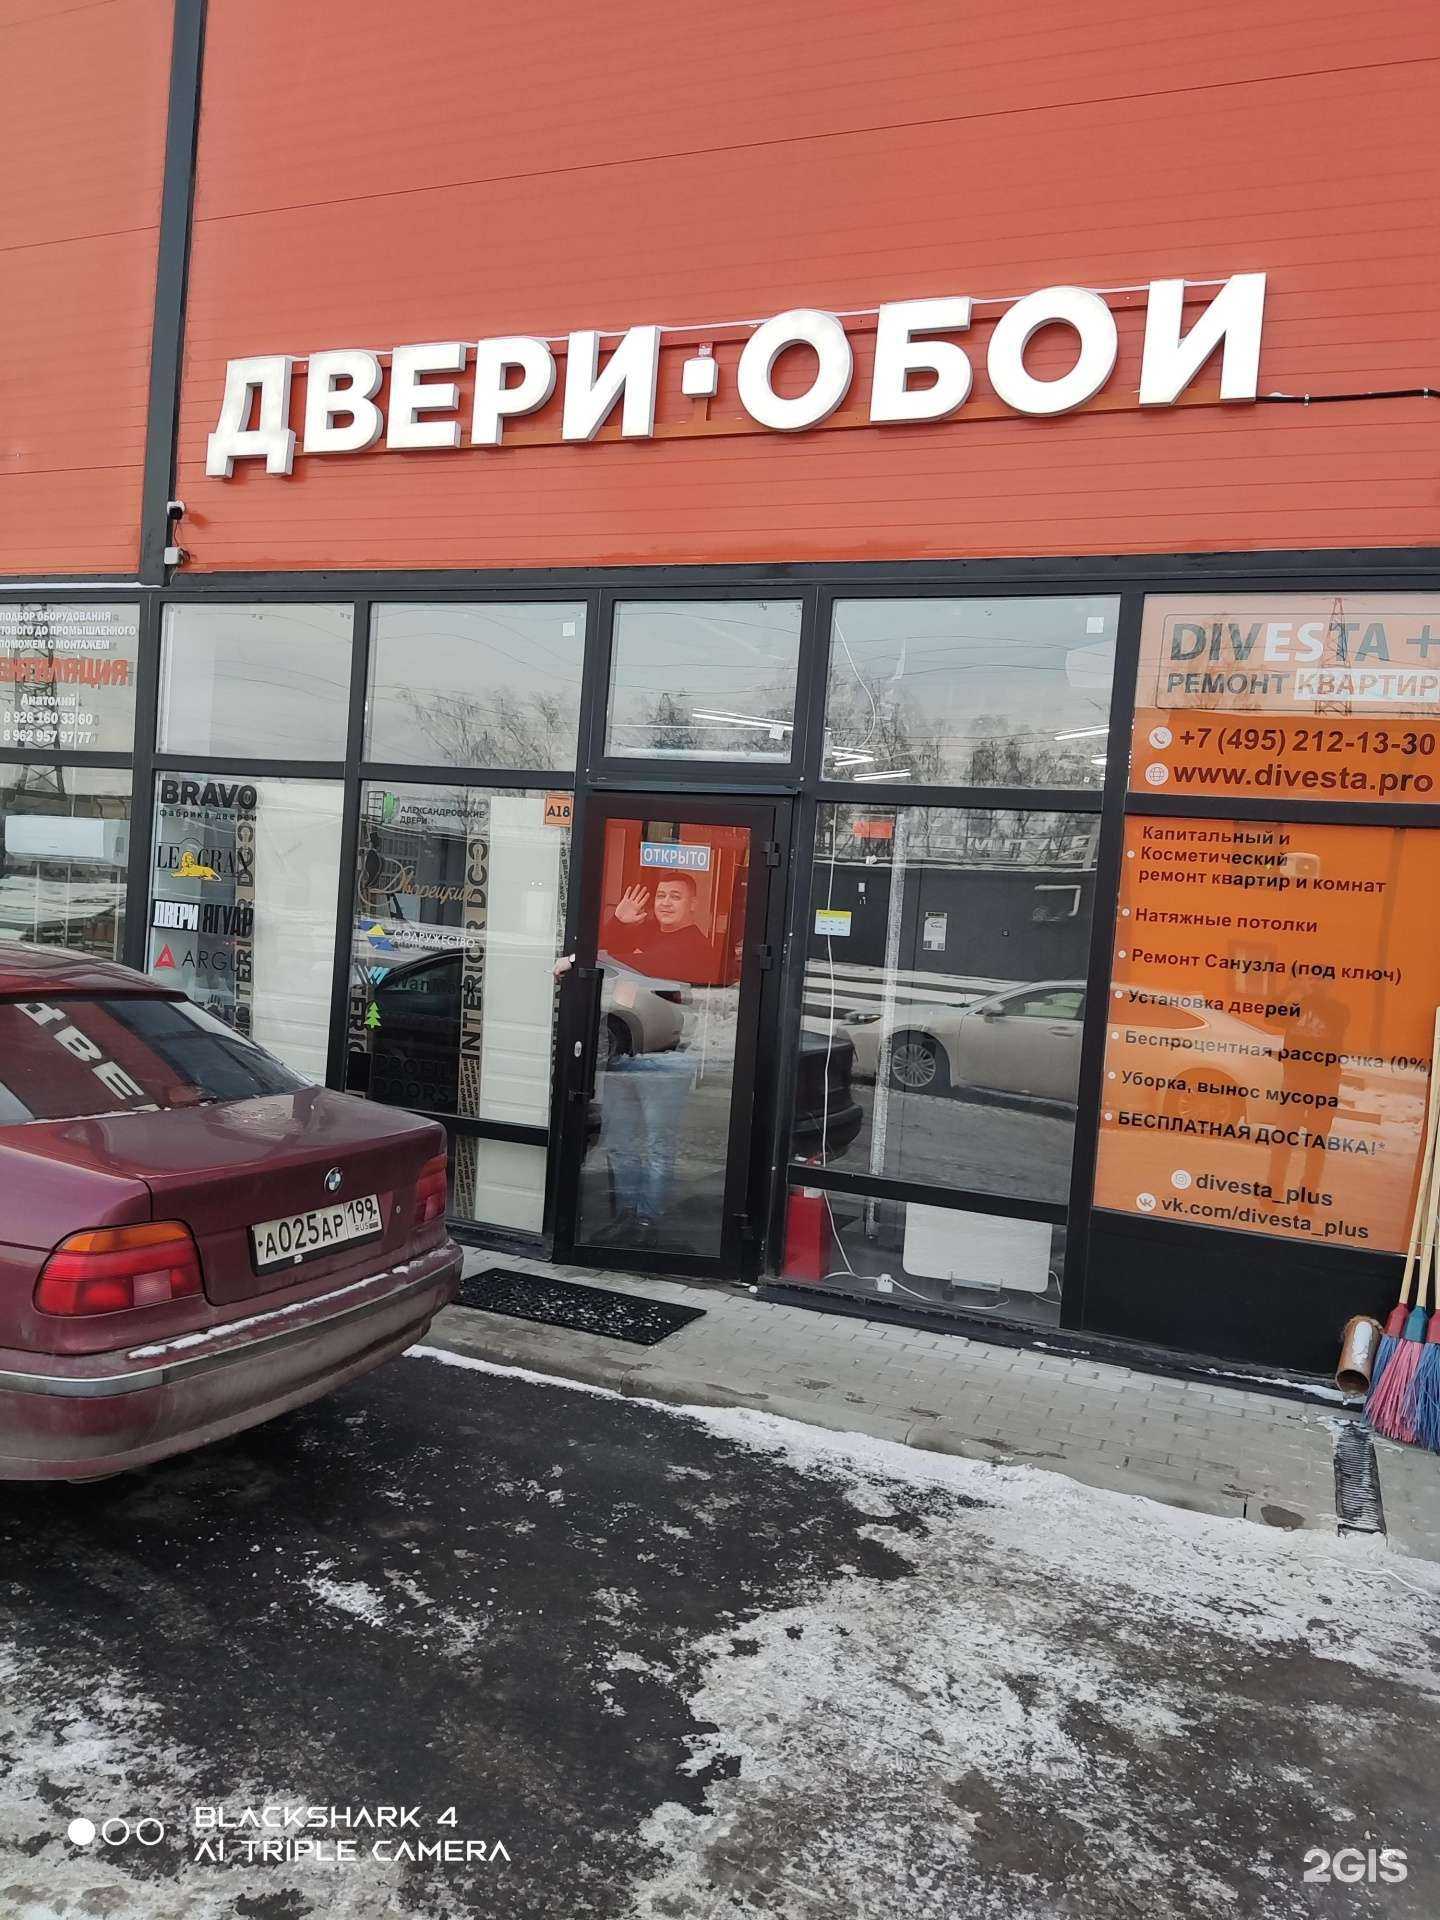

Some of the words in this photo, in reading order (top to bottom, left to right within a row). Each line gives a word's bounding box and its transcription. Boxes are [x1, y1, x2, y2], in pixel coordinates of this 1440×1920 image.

[205, 324, 662, 478] ДВЕРИ
[737, 272, 1267, 432] ОБОИ
[37, 612, 111, 622] ОБОРУДОВАНИЯ
[0, 625, 33, 635] ТОВОГО
[35, 626, 49, 637] ДО
[50, 626, 136, 636] ПРОМЫШЛЕННОГО
[1170, 622, 1390, 662] DIVESTA
[57, 641, 110, 650] МОНТАЖЕМ
[1167, 672, 1289, 695] РЕМОНТ
[21, 693, 76, 707] Анатолий
[1179, 728, 1213, 749] +7
[1217, 728, 1286, 756] (495)
[1292, 729, 1436, 755] 212-13-30
[1173, 763, 1434, 796] www.divesta.pro
[161, 780, 257, 810] BRAVO
[400, 806, 485, 819] АЛЕКСАНДРОВСКИЕ
[400, 816, 428, 825] ДВЕРИ
[1142, 825, 1273, 845] Капитальный
[1279, 833, 1290, 845] и
[643, 847, 707, 866] ОТКРЫТО
[1140, 846, 1288, 867] Косметический
[1139, 870, 1207, 884] ремонт
[1211, 872, 1290, 891] квартир
[1296, 877, 1307, 889] и
[1313, 878, 1386, 893] комнат
[153, 900, 199, 931] ДВЕРИ
[1135, 907, 1232, 927] Натяжные
[1237, 917, 1318, 933] потолки
[394, 929, 476, 948] СОДРУЖЕСТВО
[1132, 948, 1200, 967] Ремонт
[1204, 954, 1286, 975] Санузла
[1291, 962, 1336, 980] (под
[1341, 967, 1402, 985] ключ)
[1128, 989, 1224, 1011] Установка
[1228, 1000, 1301, 1018] дверей
[1125, 1030, 1272, 1058] Беспроцентная
[1277, 1047, 1384, 1070] рассрочка
[1122, 1070, 1192, 1093] Уборка,
[1197, 1082, 1260, 1099] вынос
[1265, 1089, 1339, 1108] мусора
[1118, 1111, 1250, 1140] БЕСПЛАТНАЯ
[1196, 1173, 1333, 1206] divesta_plus
[347, 1198, 373, 1224] 199
[1161, 1197, 1369, 1239] vk.com/divesta_plus
